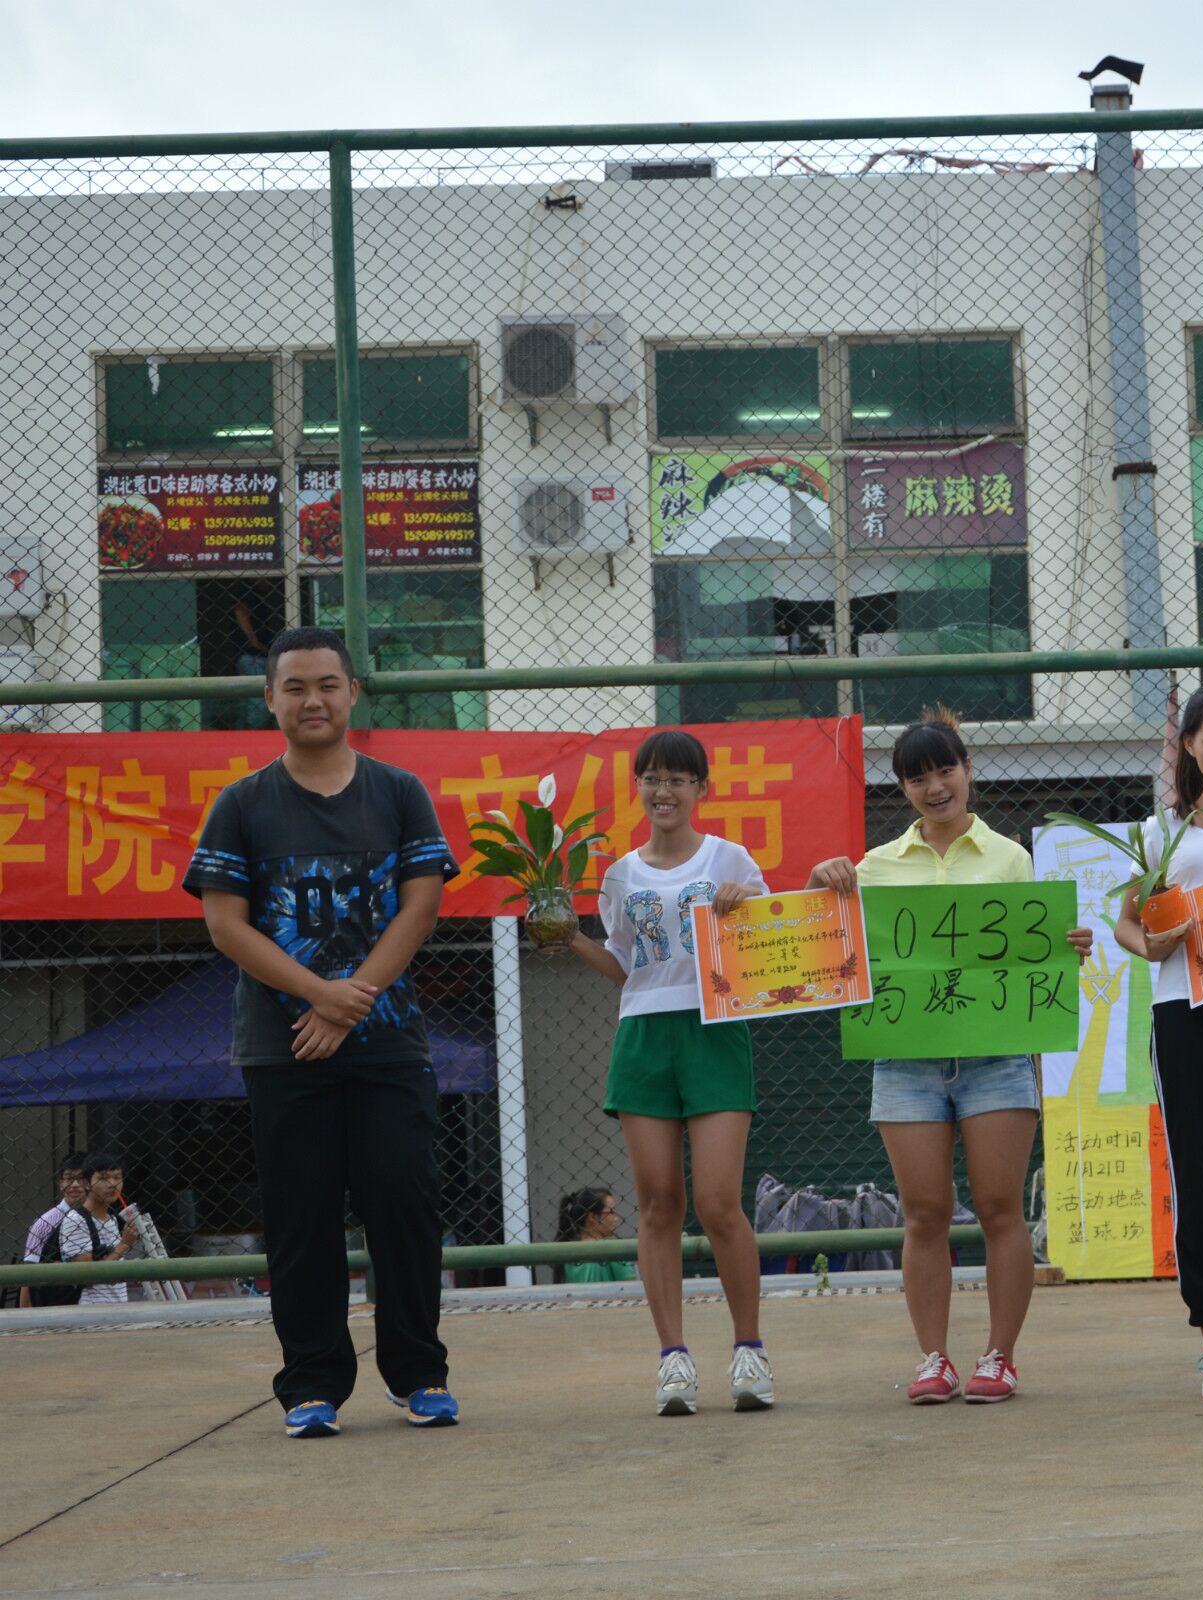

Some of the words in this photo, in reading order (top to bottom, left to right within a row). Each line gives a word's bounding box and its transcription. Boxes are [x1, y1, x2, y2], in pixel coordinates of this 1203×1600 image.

[303, 469, 476, 492] 湖北重味自助餐各式小炒
[904, 472, 1015, 518] 麻辣烫
[868, 898, 1053, 964] 0433
[1055, 1130, 1142, 1153] 活动时间
[1065, 1159, 1125, 1177] 11月21日
[1055, 1186, 1147, 1212] 活动地点
[1068, 1219, 1145, 1244] 篮球场
